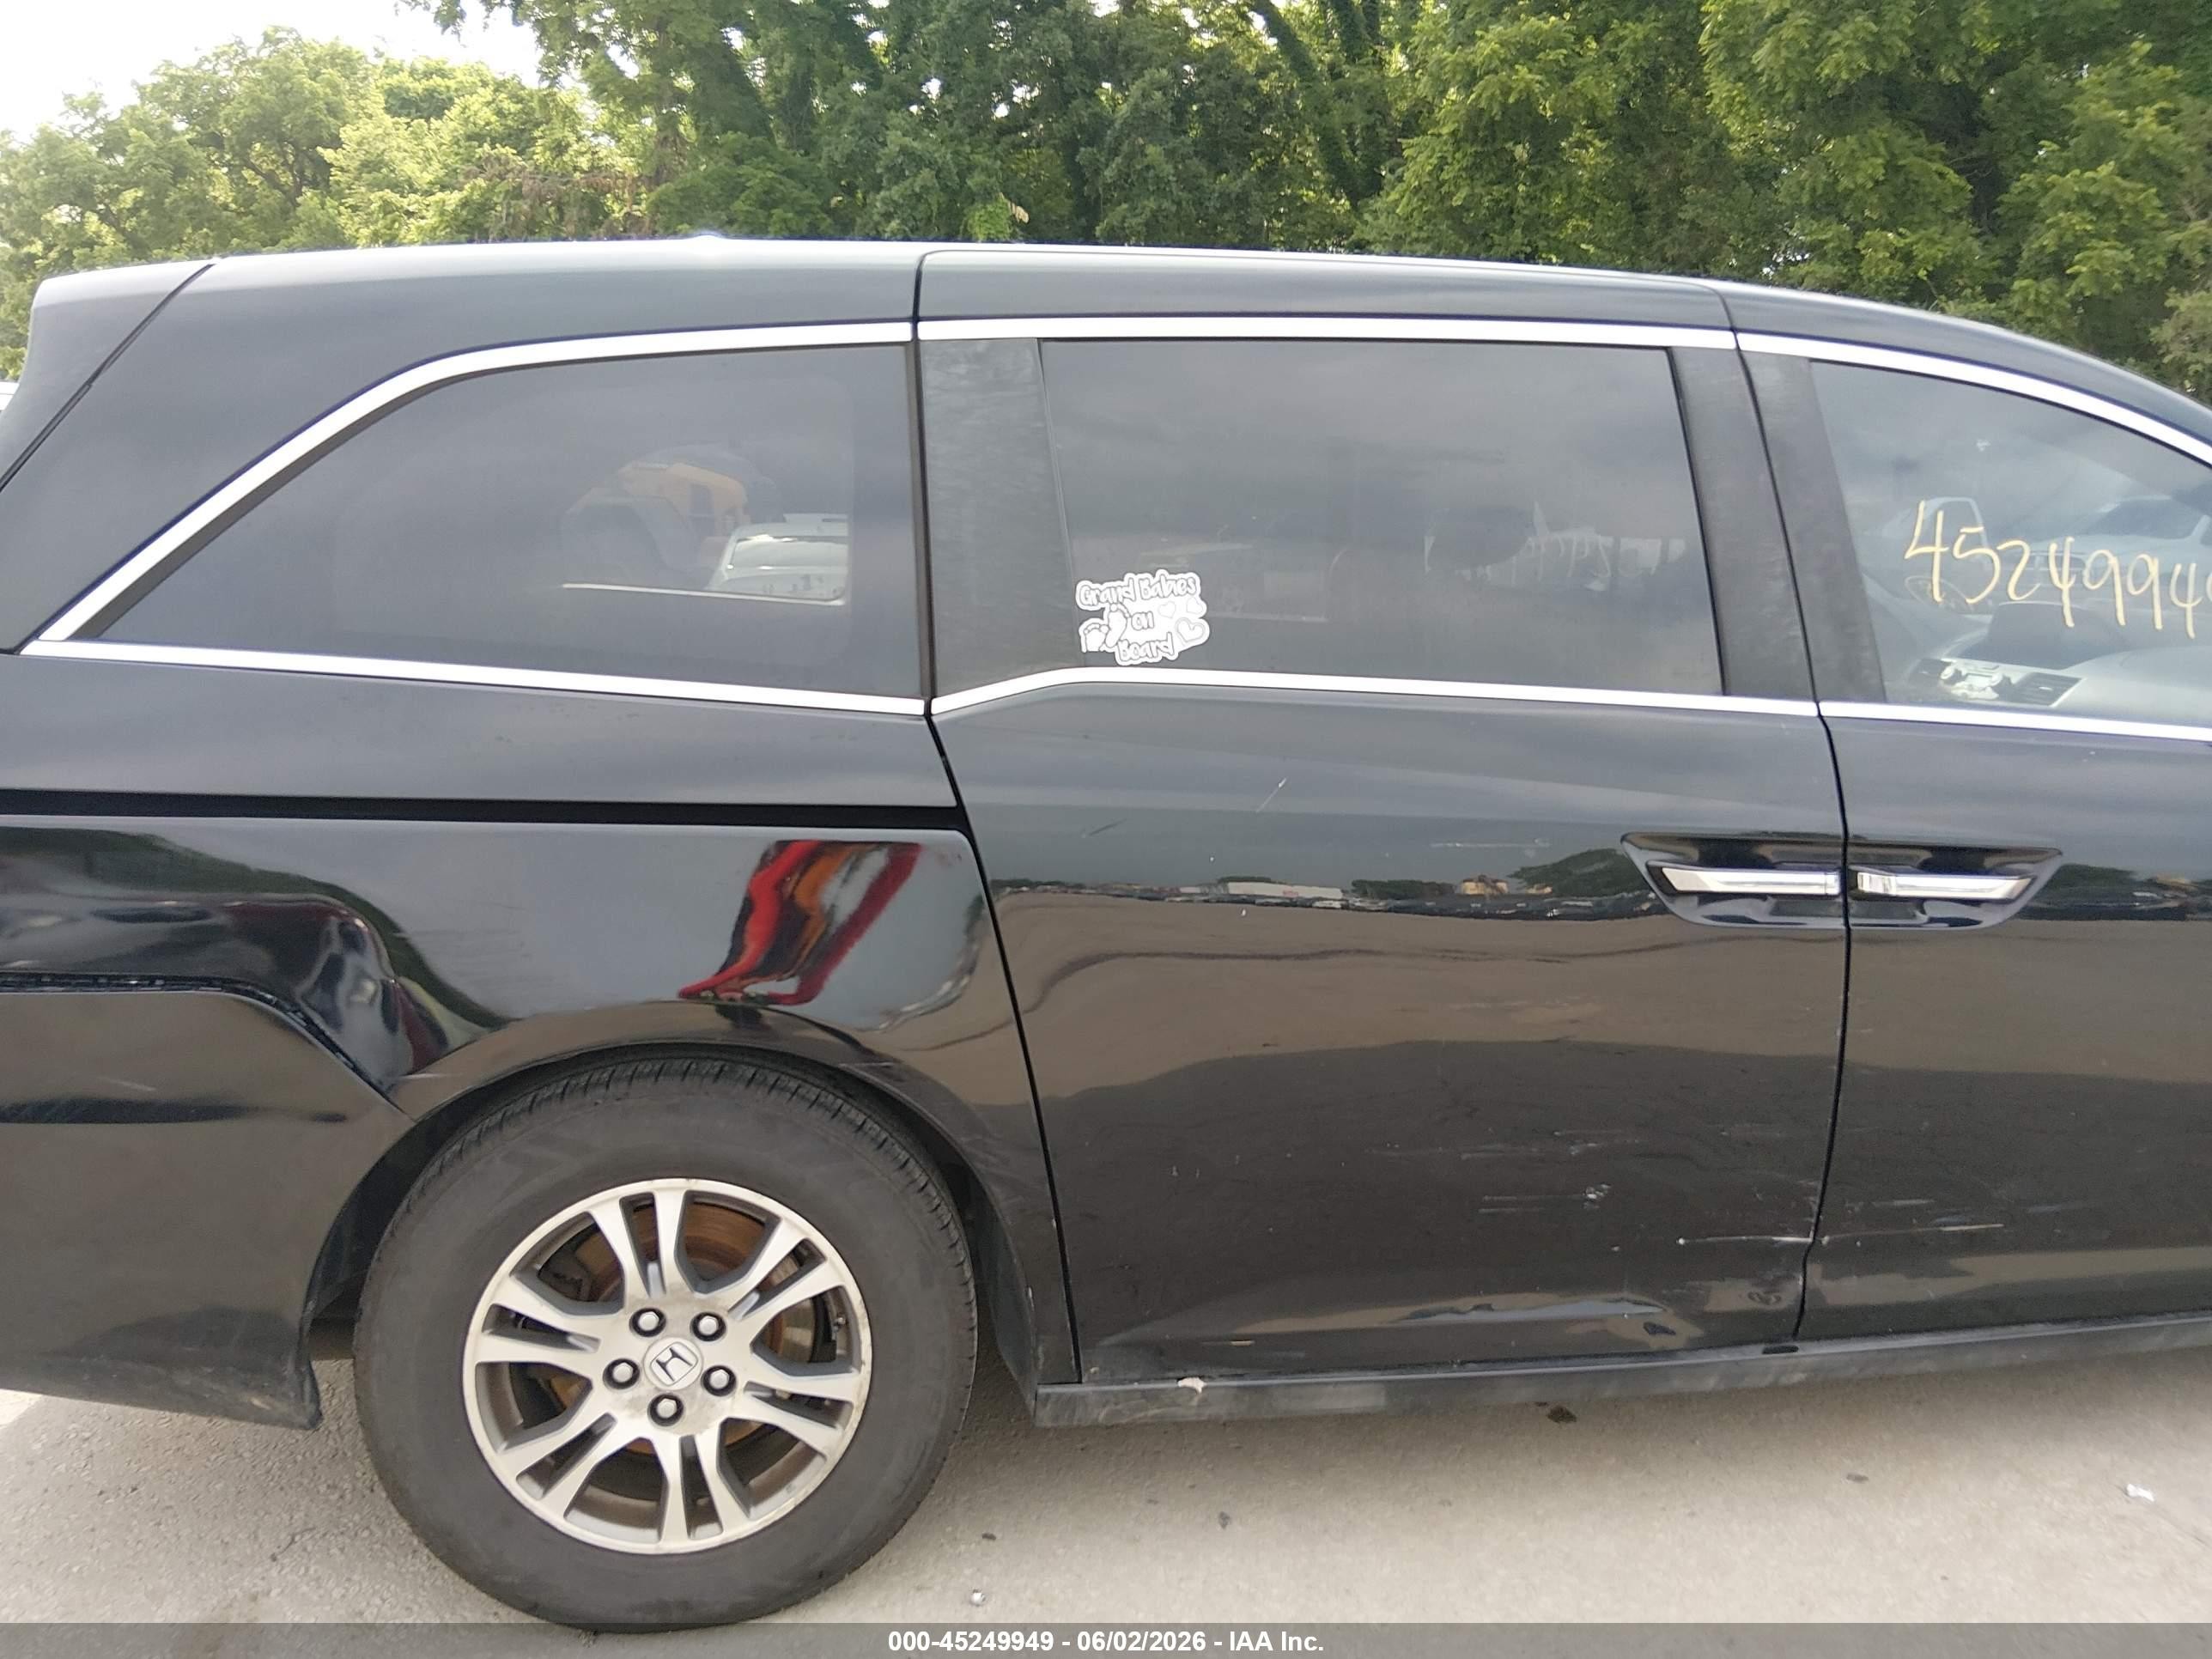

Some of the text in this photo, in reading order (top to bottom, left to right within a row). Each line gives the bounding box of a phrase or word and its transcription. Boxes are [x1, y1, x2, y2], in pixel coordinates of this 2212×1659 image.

[1904, 498, 2212, 640] 4524994
[1079, 574, 1195, 606] Grand Babies
[1117, 632, 1175, 661] Board
